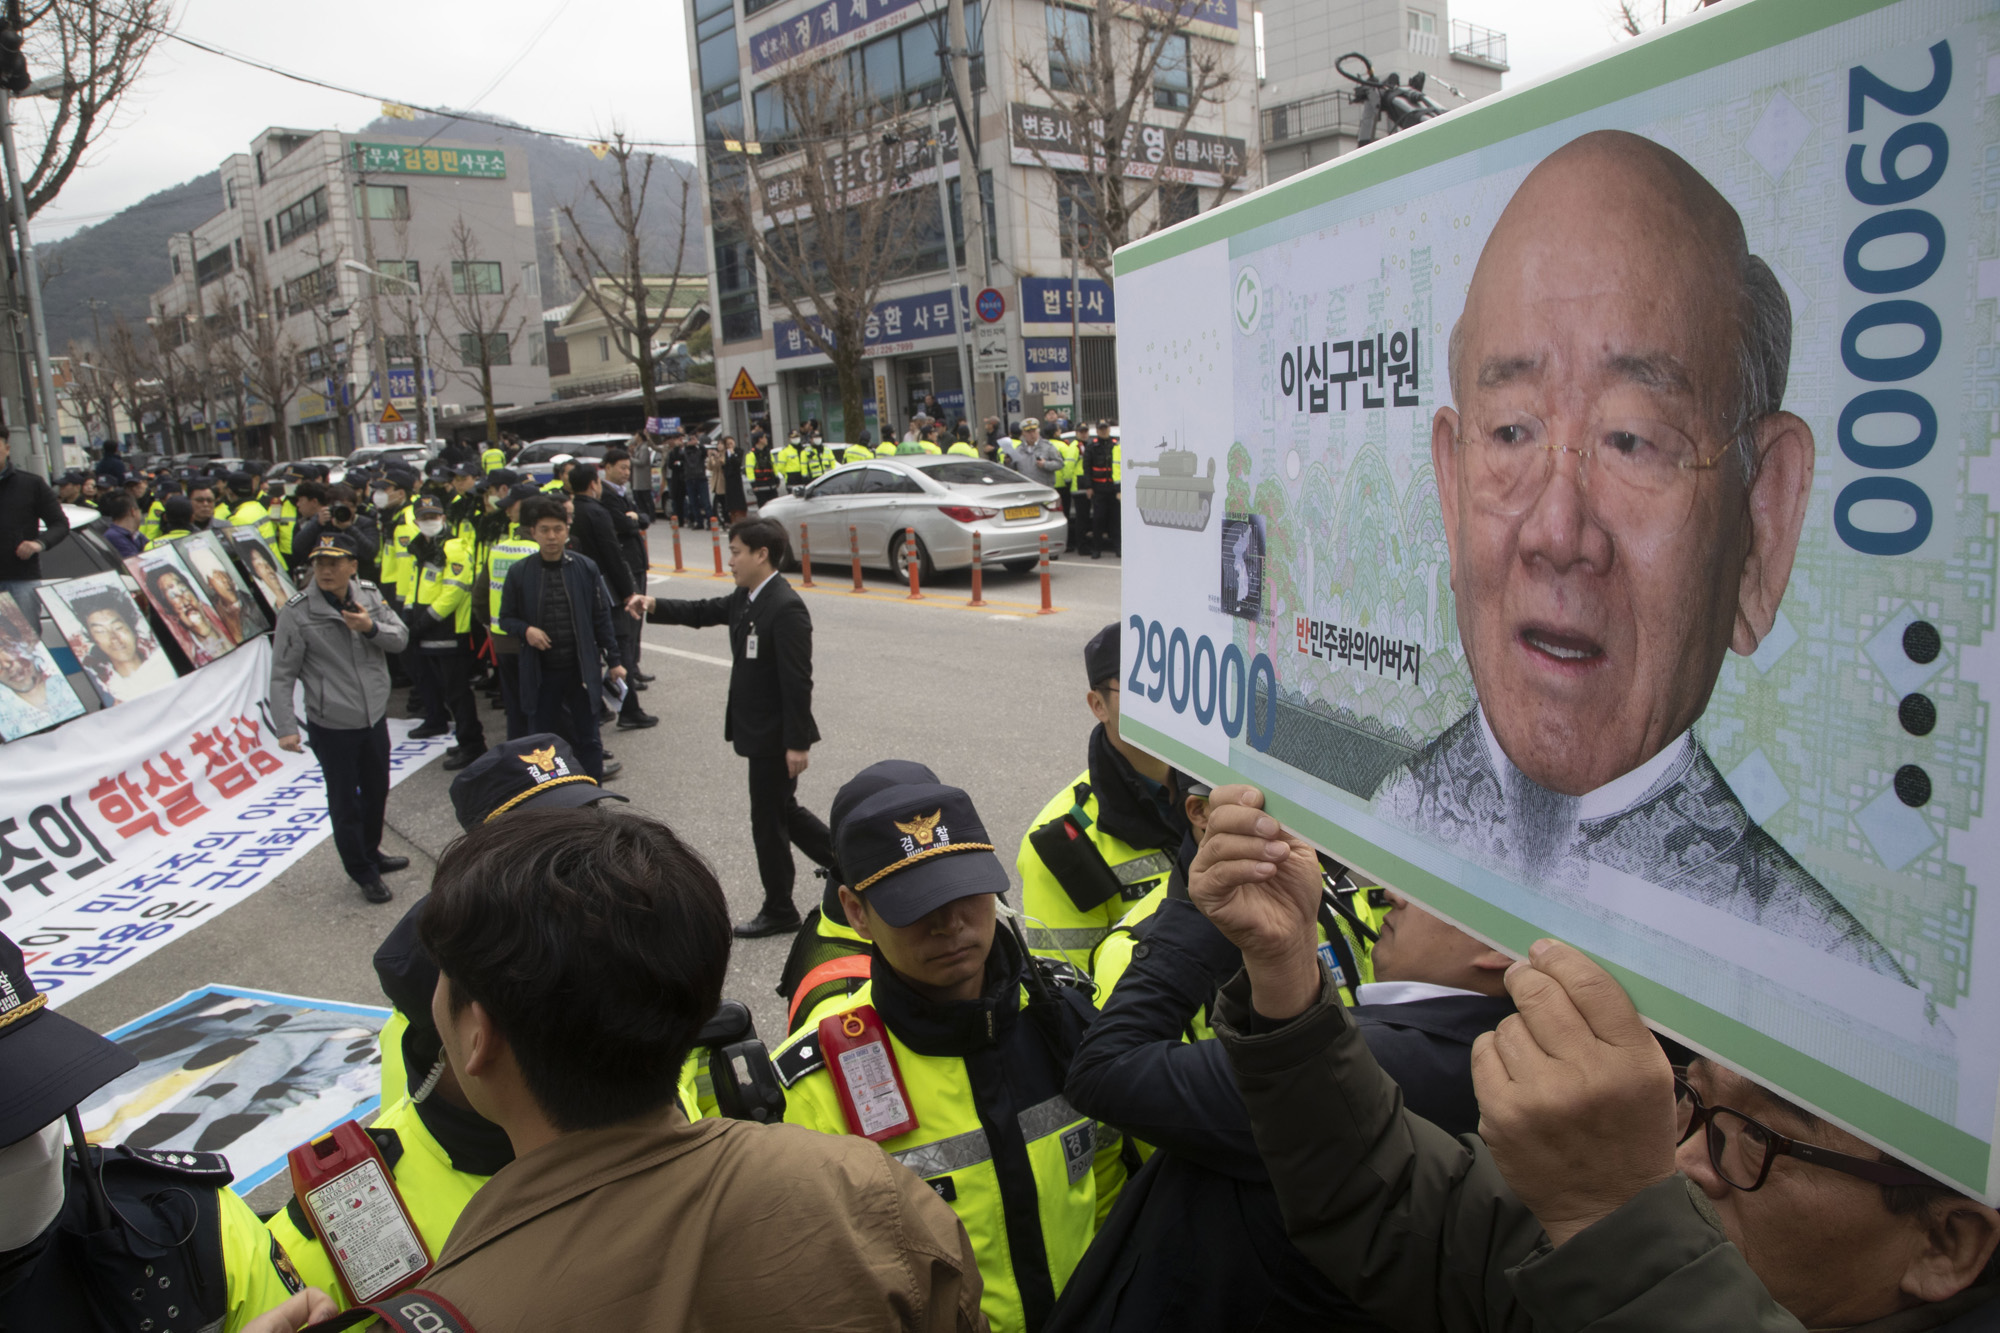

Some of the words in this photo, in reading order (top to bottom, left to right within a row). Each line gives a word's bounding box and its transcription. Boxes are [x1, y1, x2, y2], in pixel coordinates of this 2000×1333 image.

[403, 148, 460, 172] 김정민
[461, 153, 505, 171] 사무소
[1021, 114, 1073, 145] 변호사
[1174, 138, 1239, 167] 법률사무소
[856, 305, 903, 339] 승환
[1043, 289, 1105, 316] 법무사
[1833, 39, 1953, 555] 290000
[1027, 347, 1068, 364] 개인회생
[1280, 327, 1419, 414] 이십구만원
[1030, 381, 1070, 396] 개인파산
[1296, 617, 1421, 686] 반민주화의아버지
[1127, 614, 1277, 752] 290000
[0, 795, 117, 923] 주의
[89, 751, 211, 837] 학살
[188, 714, 284, 800] 참상
[32, 901, 215, 993] 이완용은
[190, 807, 331, 891] 근대화의
[74, 830, 258, 913] 민주주의
[400, 1302, 453, 1333] EO
